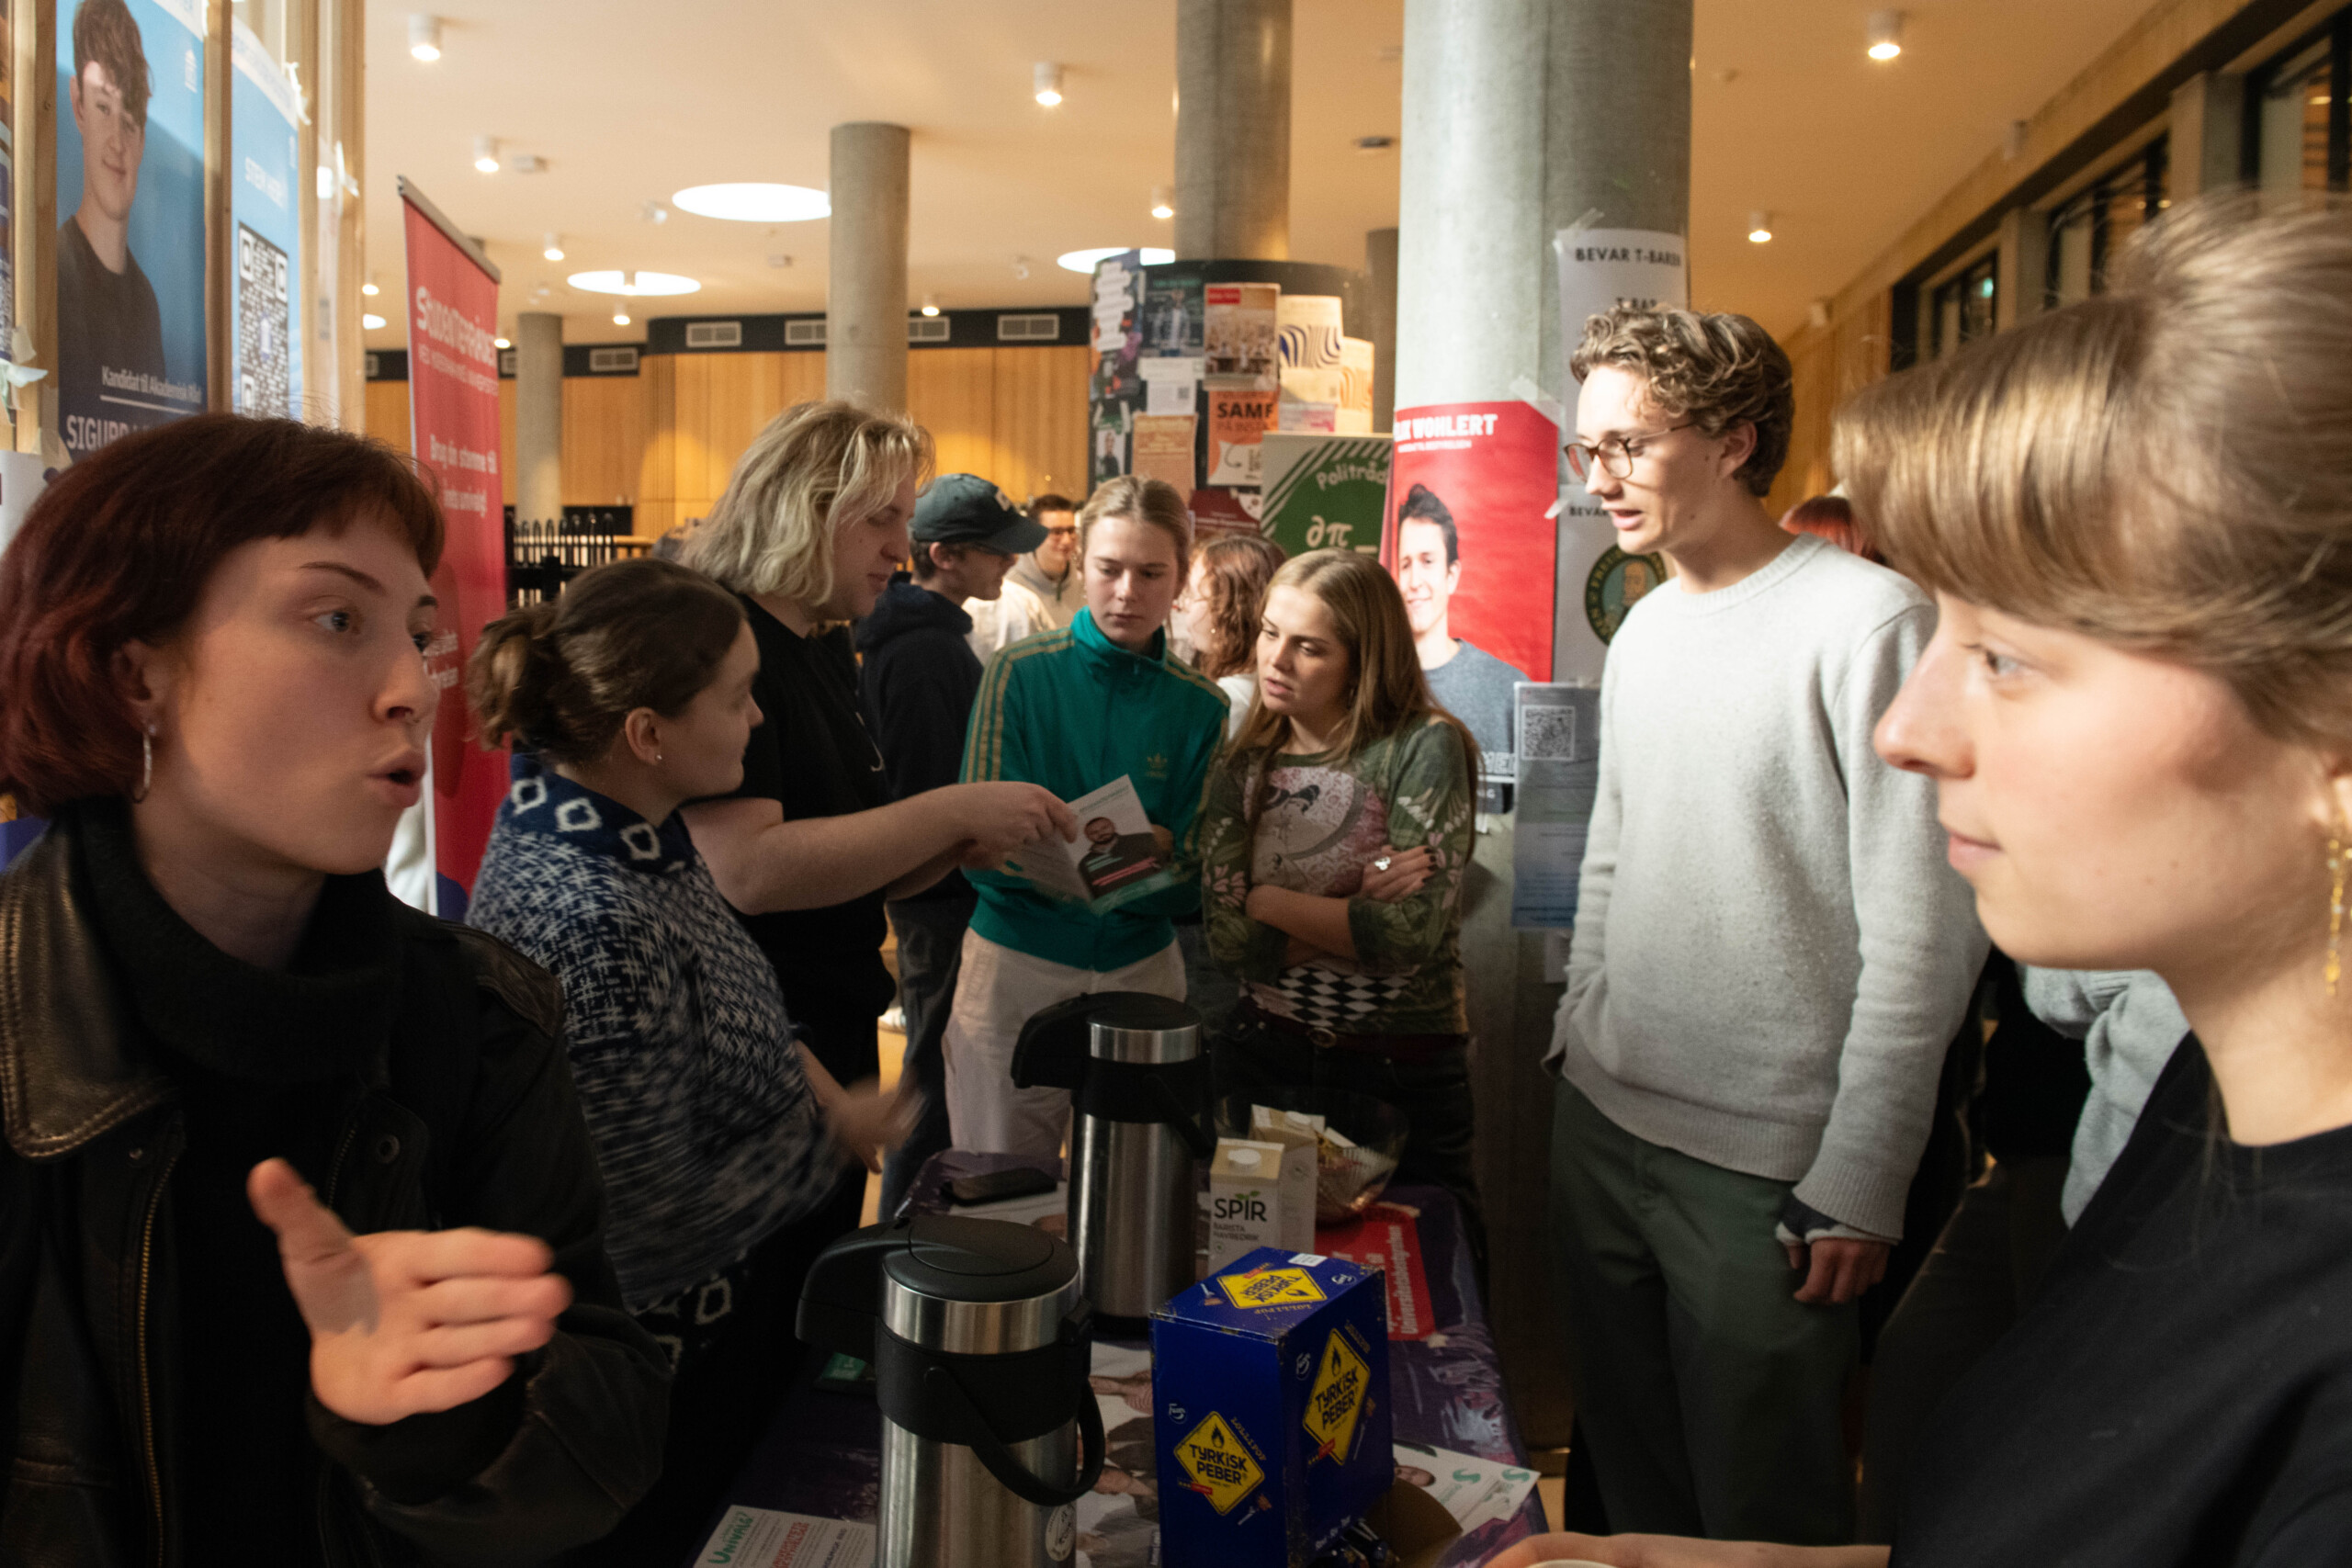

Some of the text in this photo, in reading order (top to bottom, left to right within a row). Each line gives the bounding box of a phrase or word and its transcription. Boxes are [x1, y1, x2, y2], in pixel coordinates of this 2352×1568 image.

[1575, 247, 1630, 262] BEVAR
[1217, 402, 1273, 419] SAMF
[1412, 413, 1498, 439] WOHLERT
[1214, 1198, 1268, 1223] SPIR
[1322, 1390, 1356, 1430] PEBER
[1196, 1461, 1243, 1486] PEBER
